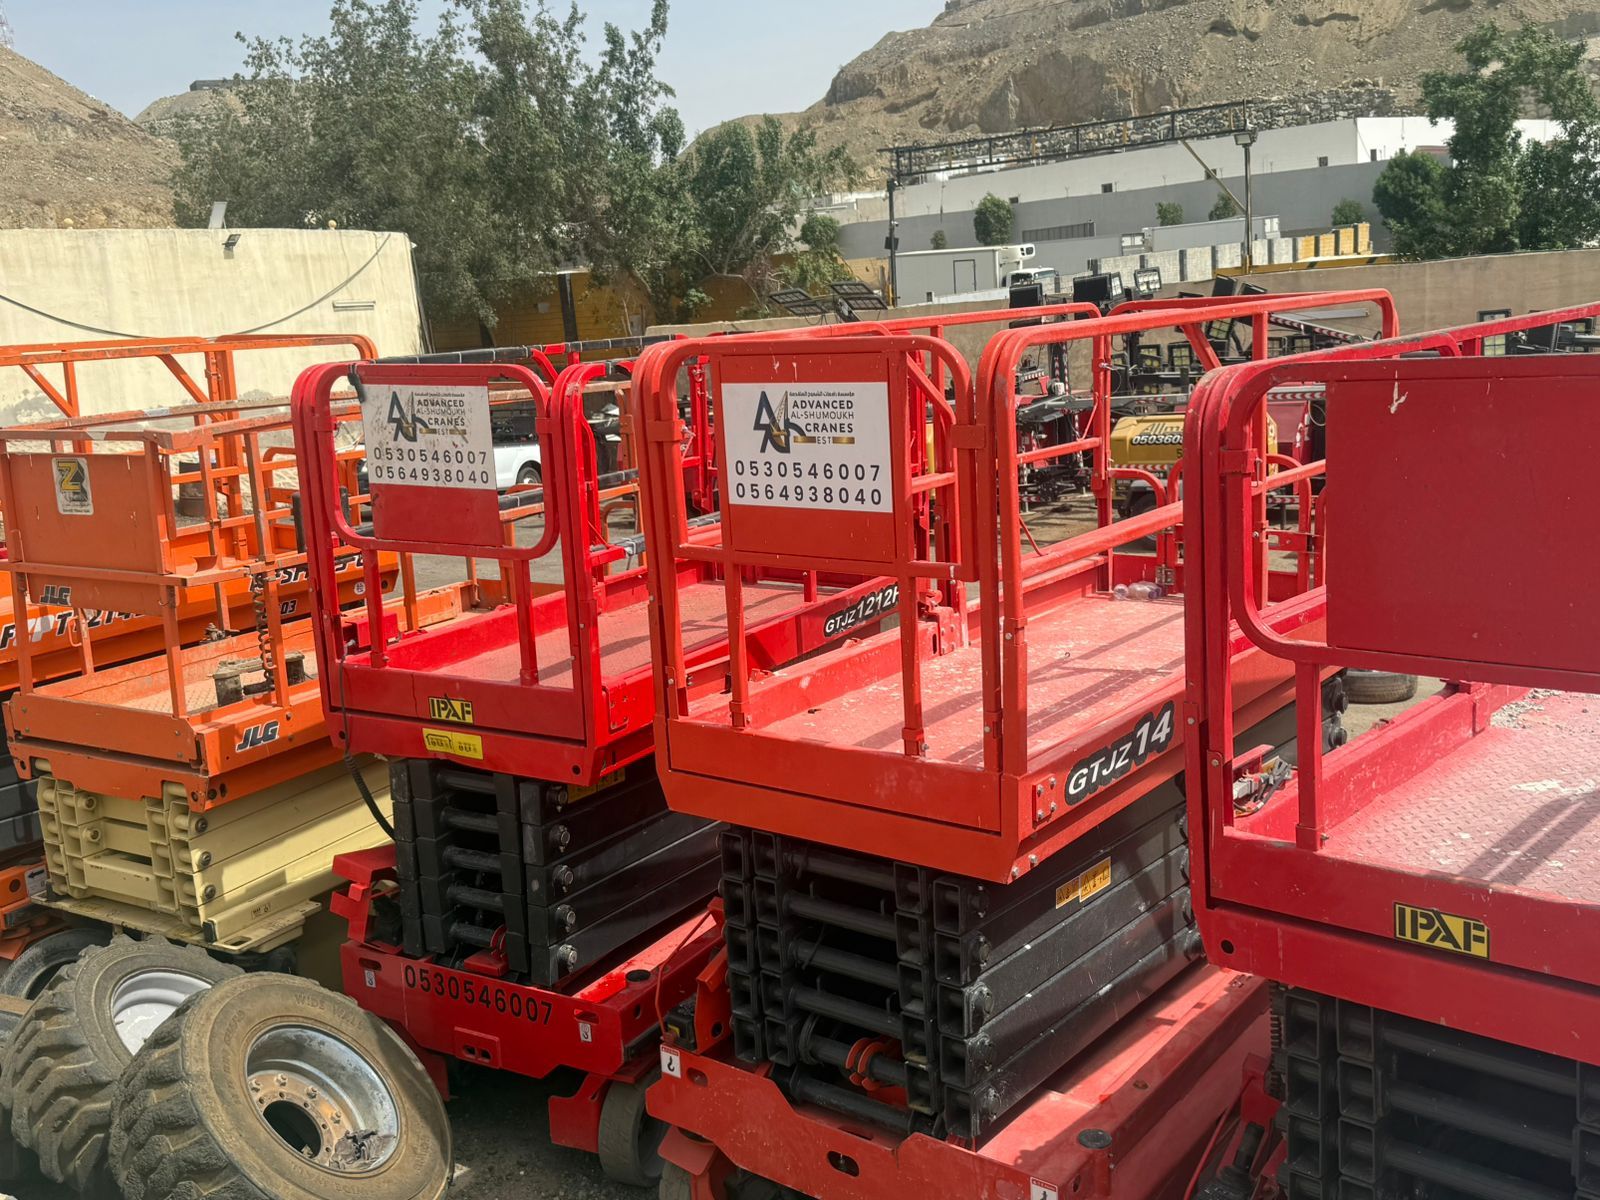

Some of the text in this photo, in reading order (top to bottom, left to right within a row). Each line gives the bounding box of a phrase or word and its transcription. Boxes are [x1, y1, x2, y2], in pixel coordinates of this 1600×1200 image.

[417, 399, 465, 408] ADVANCED
[792, 400, 854, 409] ADVANCED
[427, 416, 466, 427] CRANES
[790, 410, 855, 420] AL-SHUMOUKH
[437, 428, 449, 436] EST
[804, 422, 854, 433] CRANES
[816, 435, 832, 445] EST
[373, 447, 487, 466] 0530546007
[375, 465, 490, 484] 0564938040
[735, 459, 881, 483] 0530546007
[735, 482, 882, 506] 0564938040
[40, 584, 71, 607] JLG
[430, 697, 472, 722] IPAF
[235, 719, 280, 753] JLG
[1397, 905, 1486, 953] IPAF
[403, 964, 553, 1026] 0530546007
